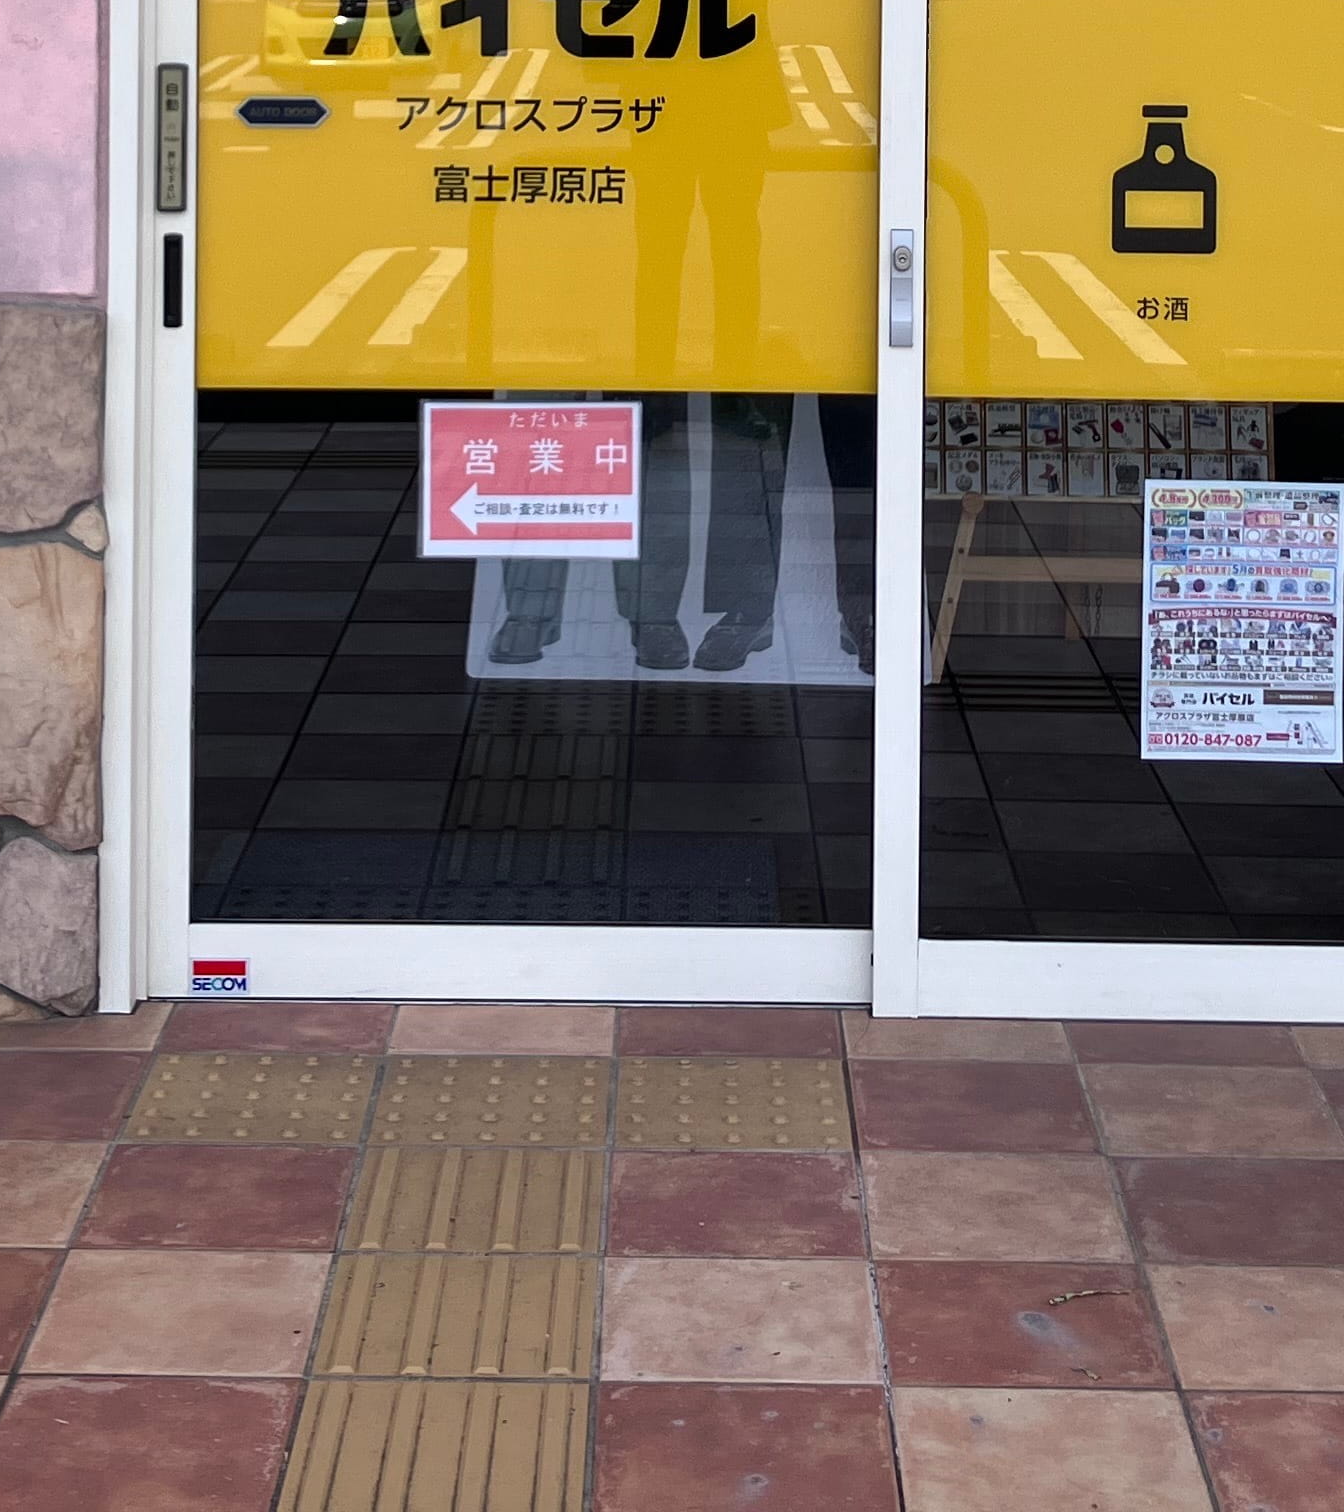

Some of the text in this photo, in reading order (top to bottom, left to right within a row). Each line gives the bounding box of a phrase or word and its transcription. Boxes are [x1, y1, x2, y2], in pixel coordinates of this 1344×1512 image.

[395, 96, 666, 133] アクロスプラザ
[432, 165, 626, 205] 富士厚原店
[1136, 296, 1190, 323] お酒
[508, 411, 589, 428] ただいま
[462, 437, 628, 475] 営業中
[1202, 692, 1256, 706] バイセル
[1164, 732, 1263, 747] 0120-847-087
[192, 977, 247, 991] SECOM
